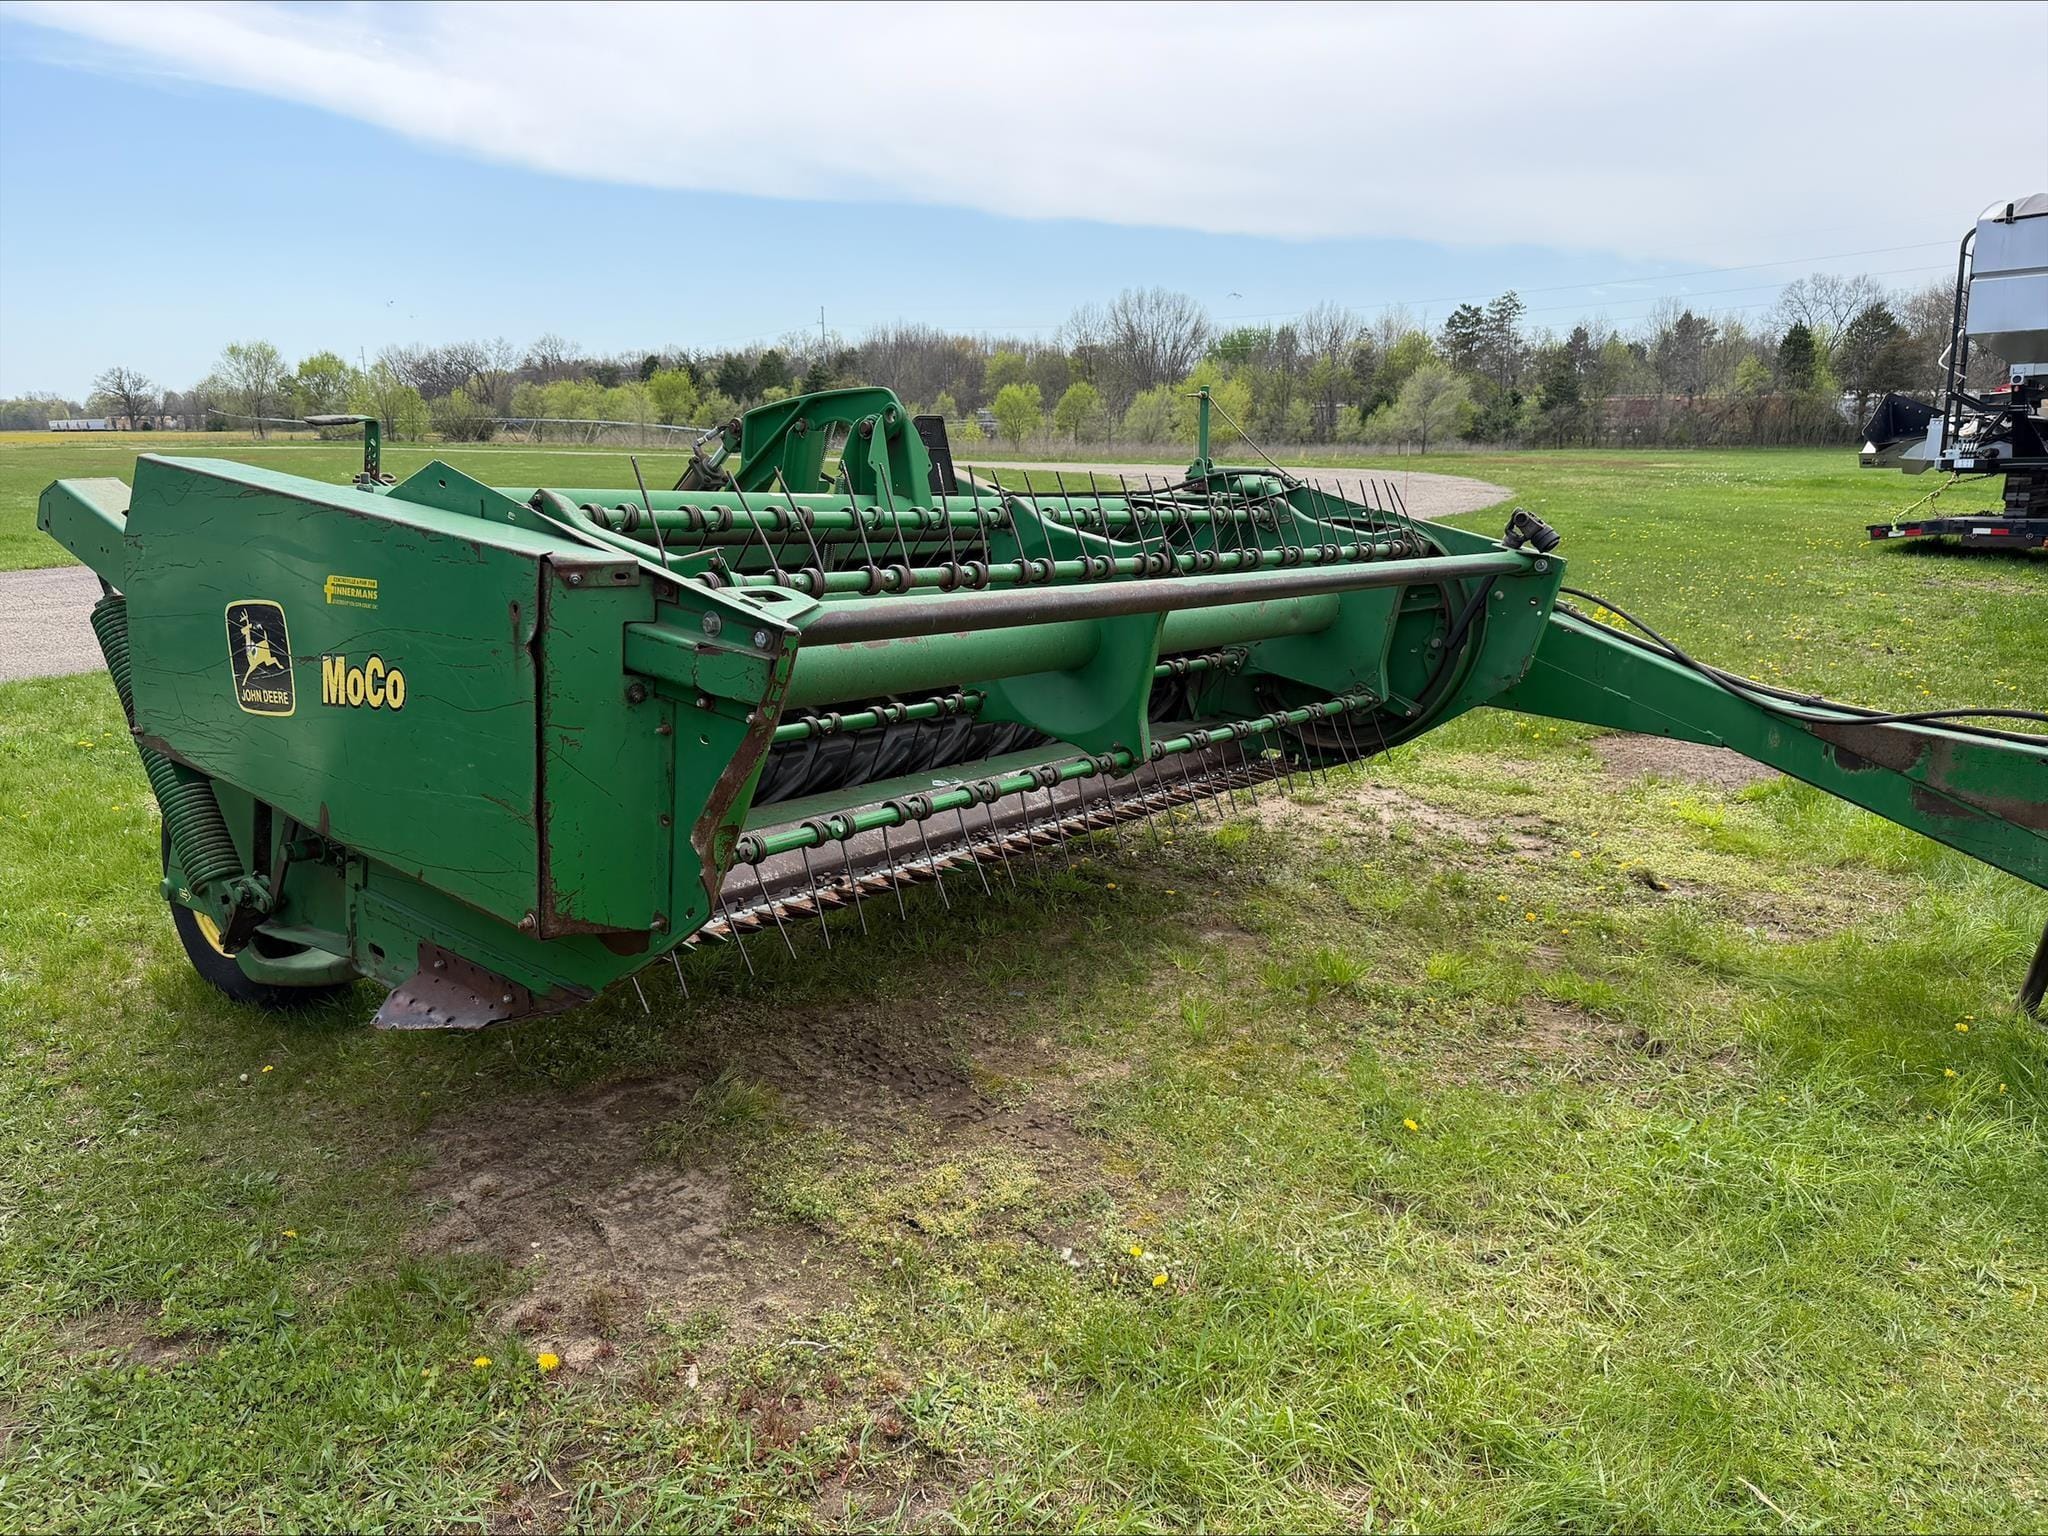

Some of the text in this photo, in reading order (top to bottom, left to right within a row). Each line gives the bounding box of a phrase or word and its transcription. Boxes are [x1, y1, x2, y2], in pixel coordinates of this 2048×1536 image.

[241, 689, 290, 705] JOHN DEERE
[322, 654, 406, 710] MoCo
